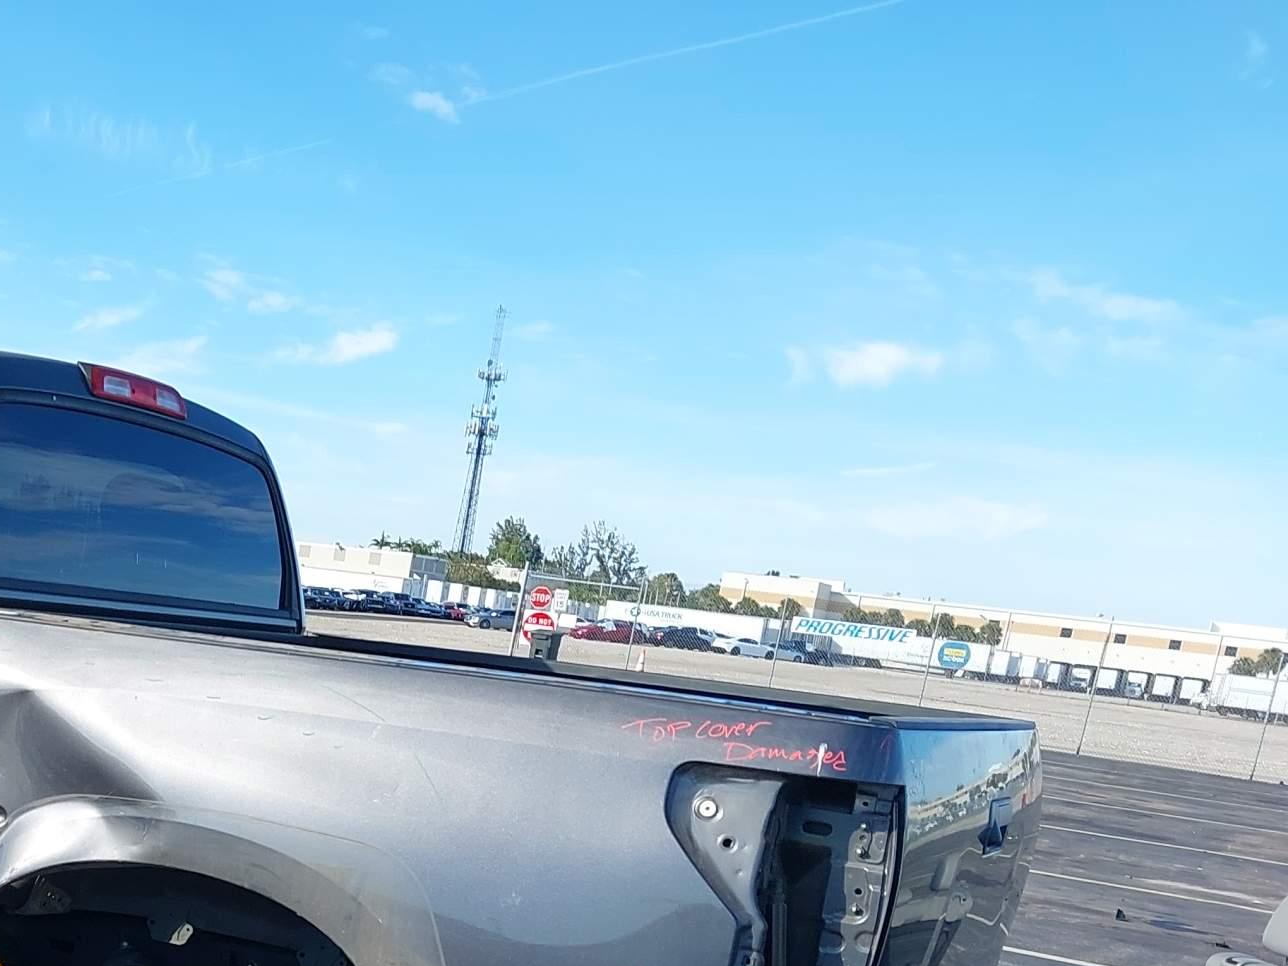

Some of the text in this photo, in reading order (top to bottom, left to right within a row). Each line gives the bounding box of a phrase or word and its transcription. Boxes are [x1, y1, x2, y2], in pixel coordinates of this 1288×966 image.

[531, 591, 551, 604] STOP
[528, 615, 553, 626] DO NOT
[795, 618, 913, 643] PROGRESSIVE
